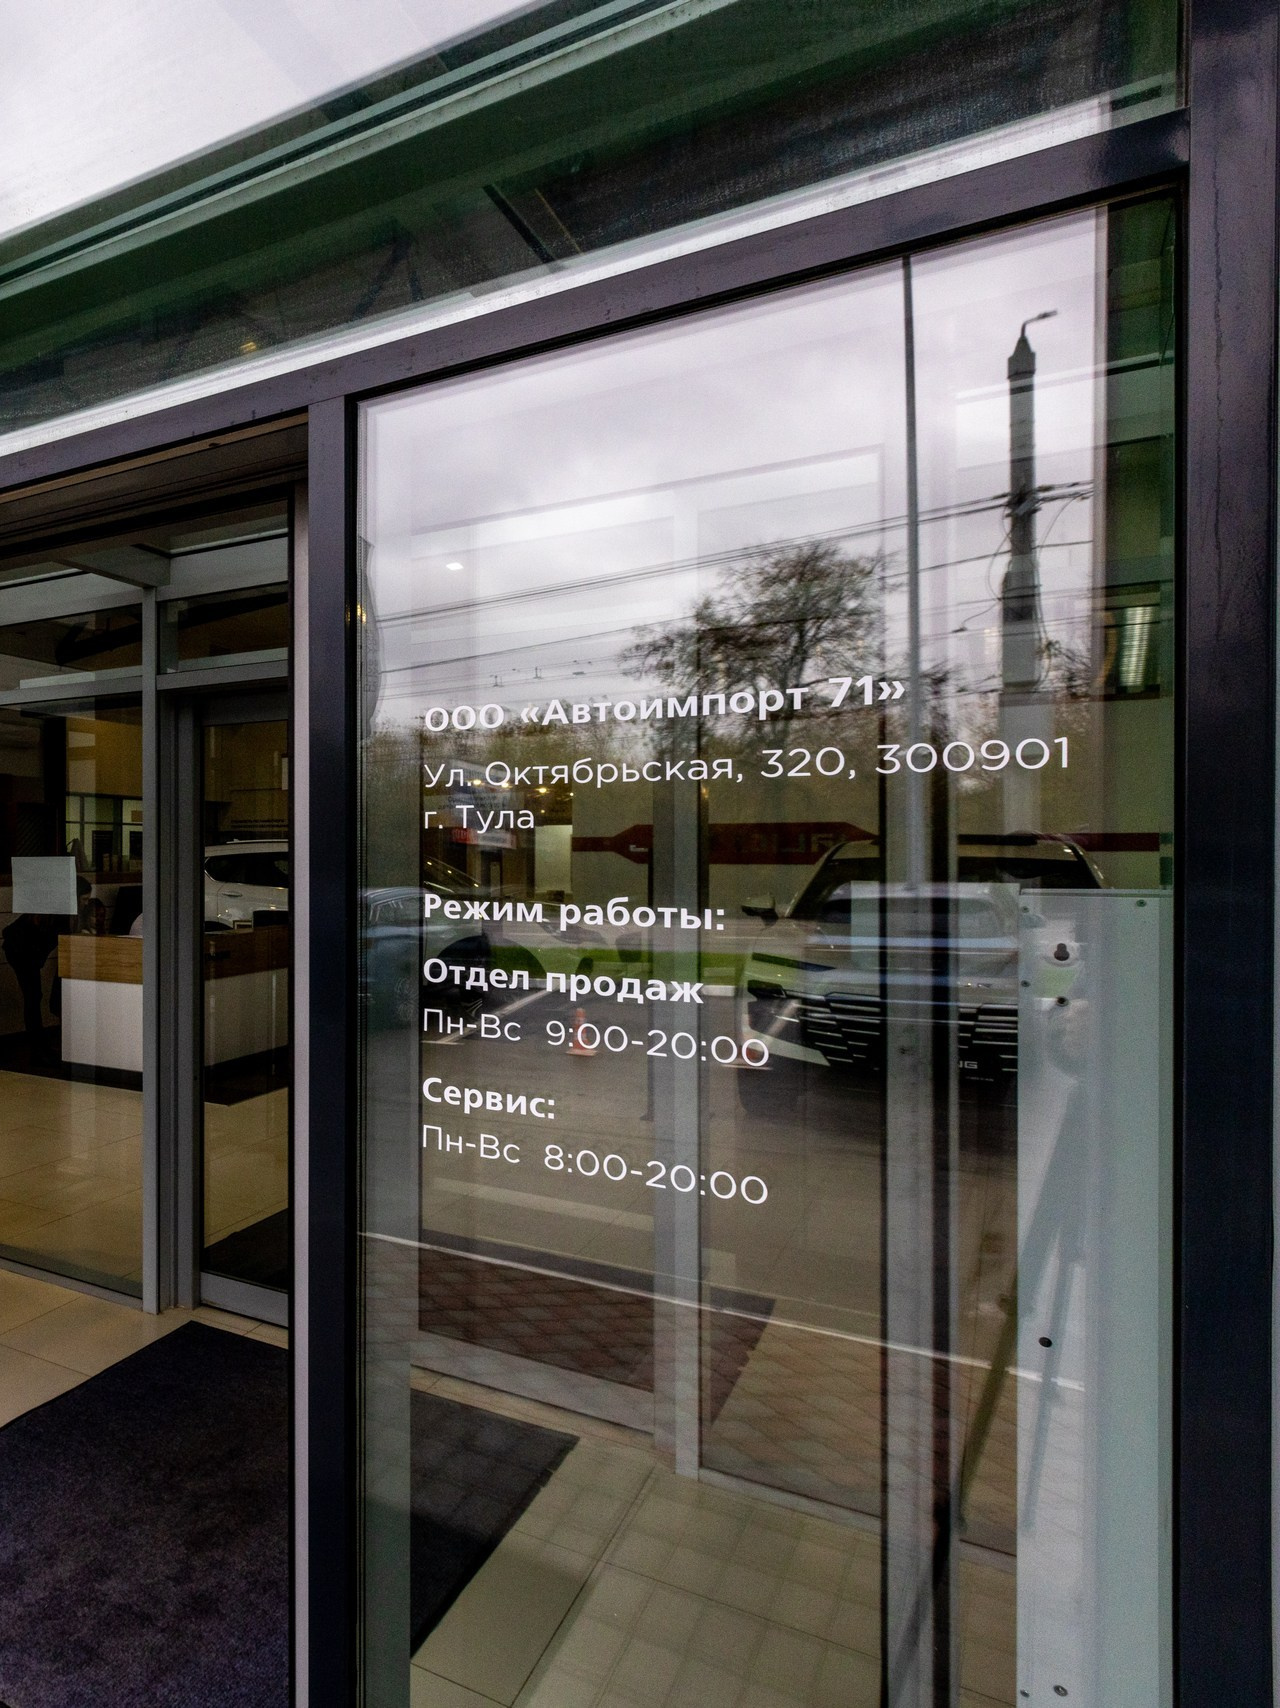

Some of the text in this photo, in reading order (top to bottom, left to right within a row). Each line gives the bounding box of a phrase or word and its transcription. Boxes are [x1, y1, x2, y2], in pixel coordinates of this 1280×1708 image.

[424, 675, 906, 732] ООО «Автоимпорт 71»
[423, 736, 1069, 789] Ул. Октябрьская, 320, 300901
[423, 804, 535, 834] г. Тула
[423, 893, 726, 932] Режим работы:
[422, 958, 705, 1005] Отдел продаж
[423, 1008, 770, 1067] Пн-Вс 9:00-20:00
[422, 1077, 556, 1120] Сервис:
[422, 1124, 769, 1206] Пн-Вс 8:00-20:00
